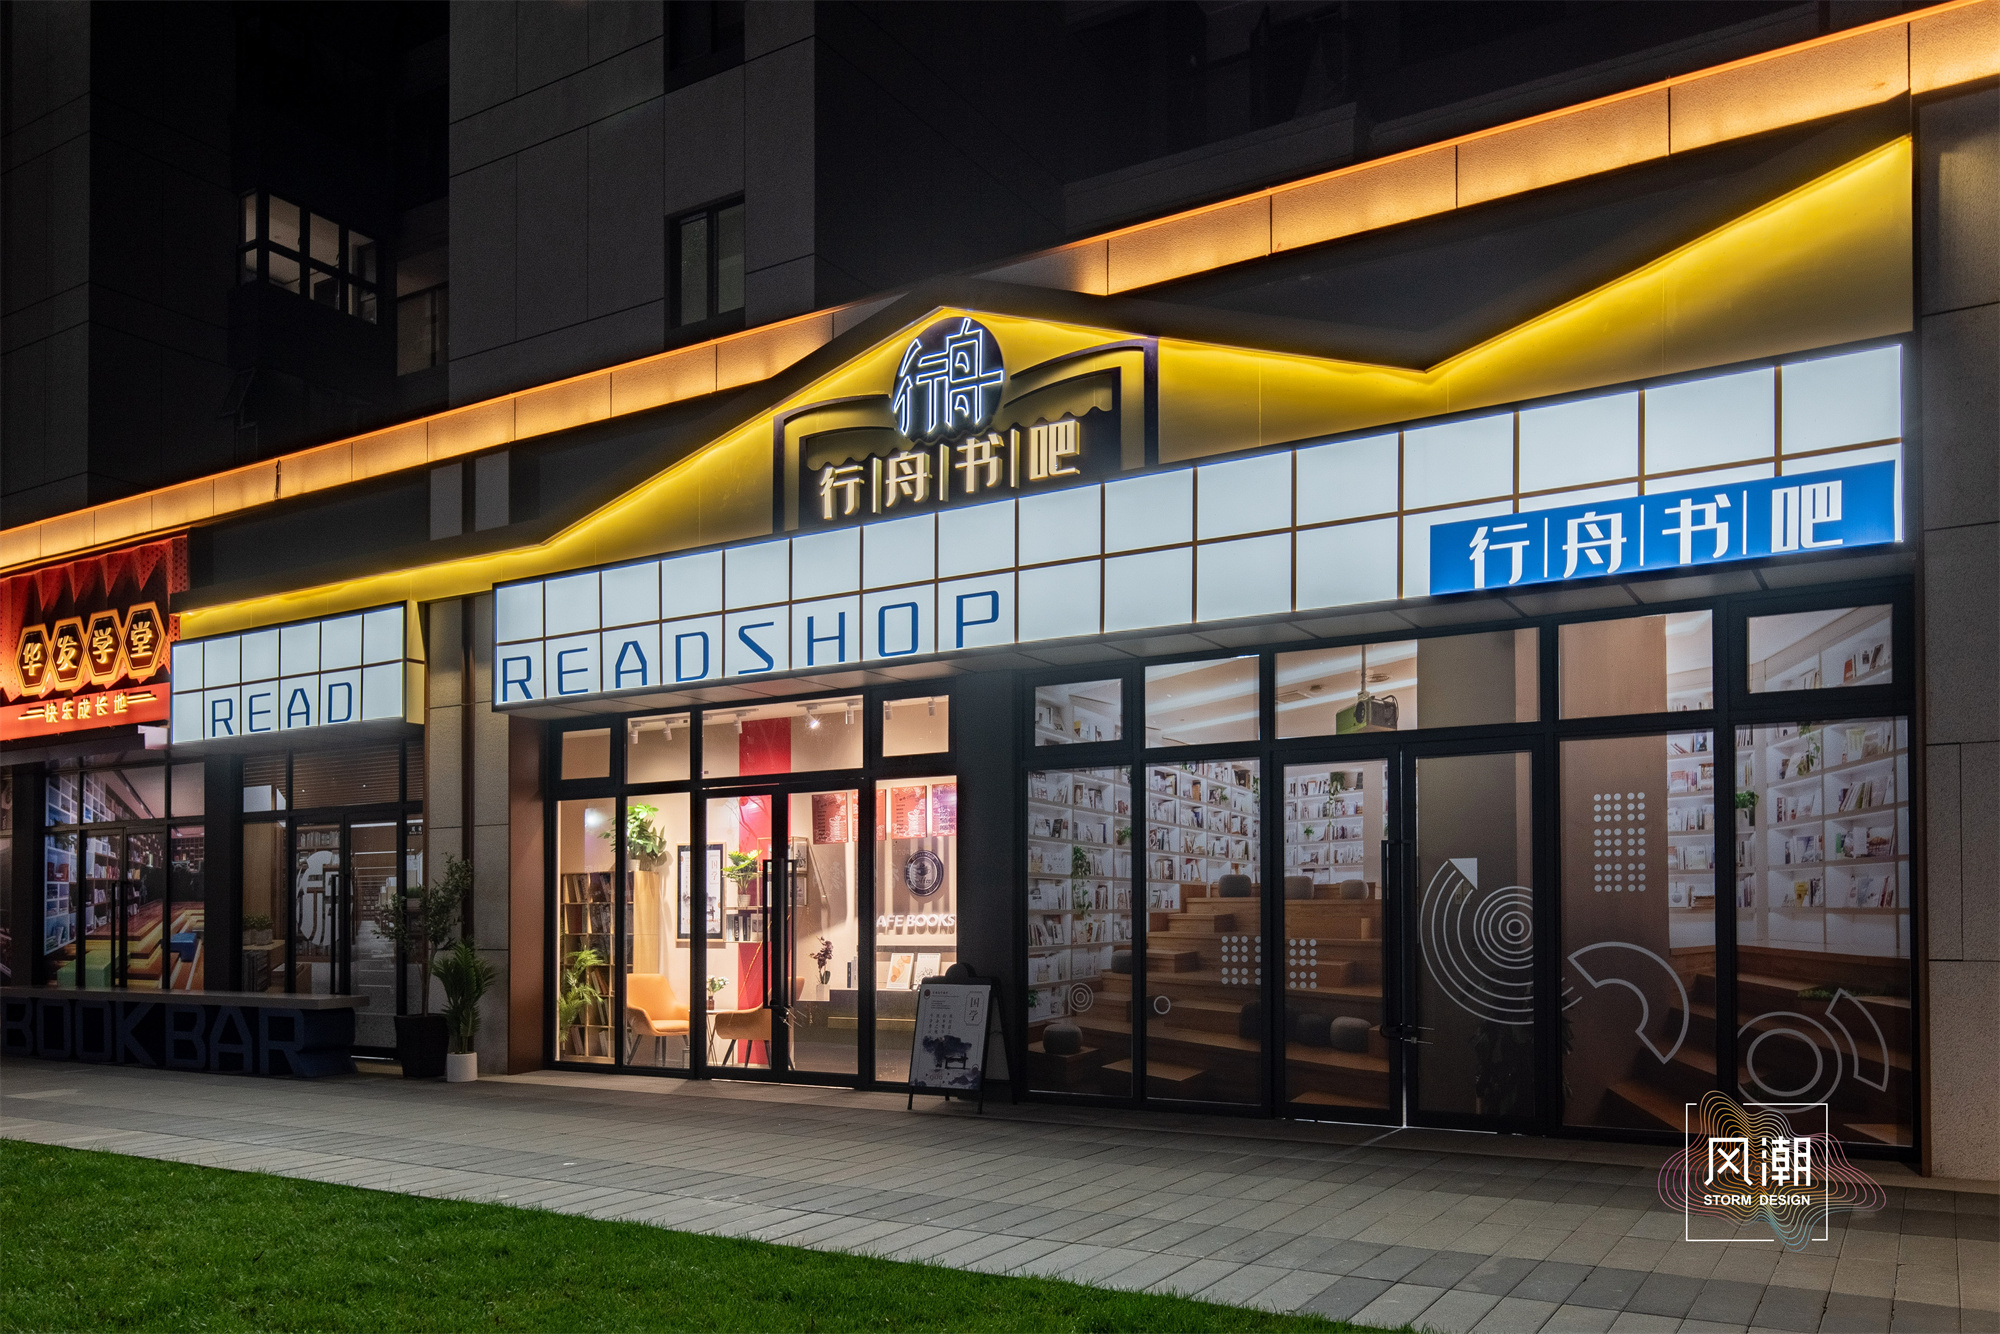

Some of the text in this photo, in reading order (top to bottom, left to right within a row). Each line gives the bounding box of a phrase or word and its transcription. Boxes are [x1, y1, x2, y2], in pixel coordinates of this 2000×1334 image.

[818, 419, 1081, 521] 行舟书吧
[1468, 479, 1843, 588] 行舟书吧
[22, 620, 154, 677] 华发学堂
[501, 589, 999, 702] READSHOP
[44, 692, 129, 724] 快乐成长地
[211, 681, 353, 738] READ
[876, 913, 955, 927] AFE BOOKS
[0, 997, 312, 1077] BOOK BAR
